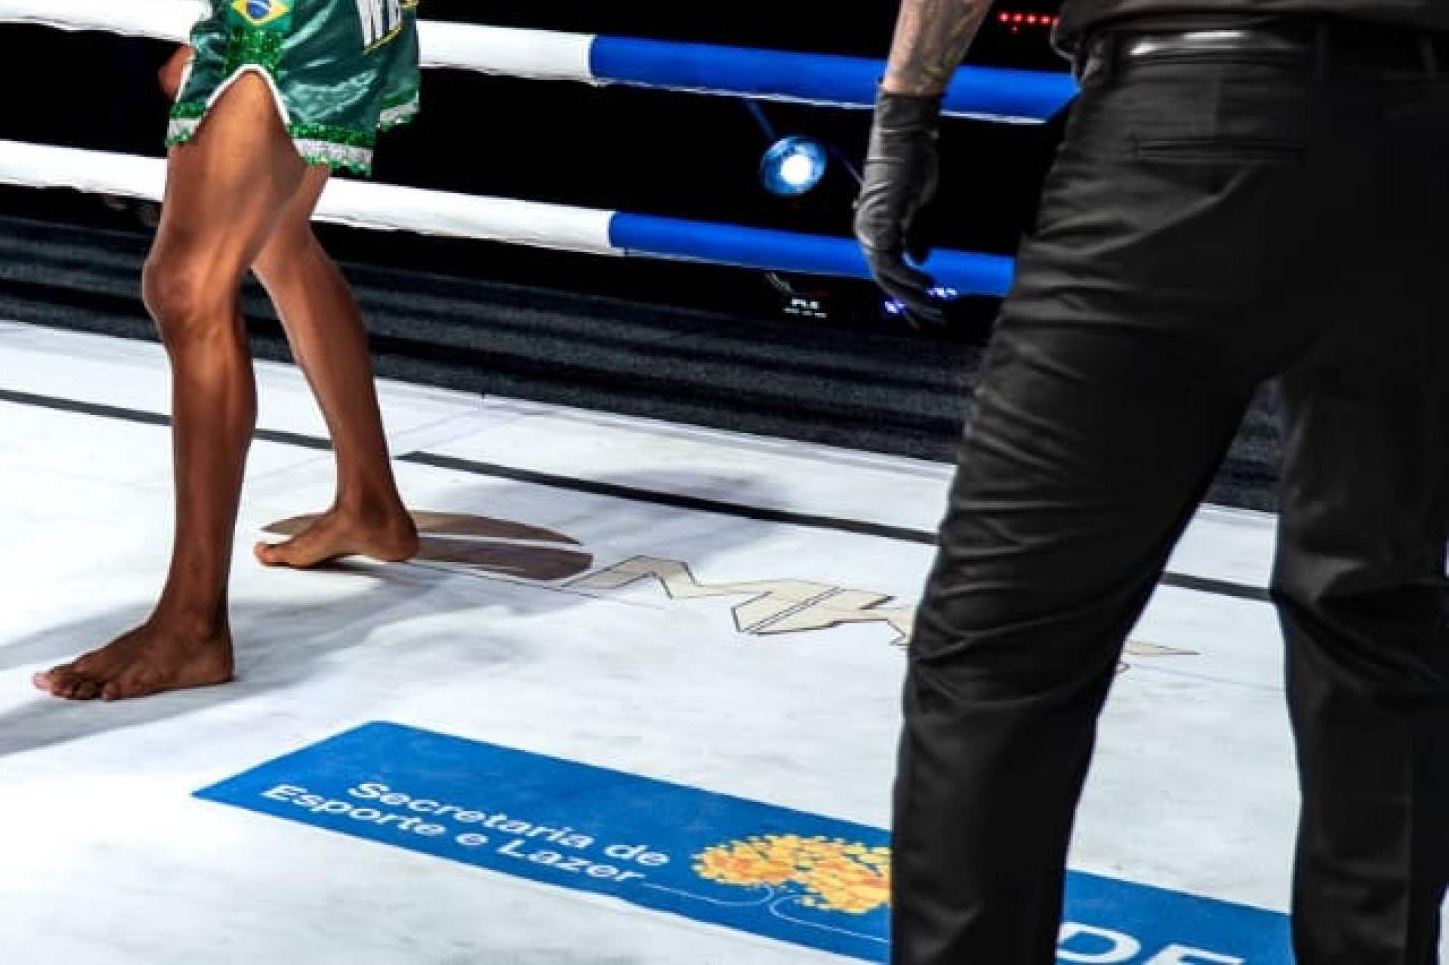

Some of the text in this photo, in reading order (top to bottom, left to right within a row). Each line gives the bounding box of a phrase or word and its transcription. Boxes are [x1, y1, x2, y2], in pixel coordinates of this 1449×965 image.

[259, 784, 647, 882] Esporte e Lazer
[347, 781, 671, 867] Secretaria de
